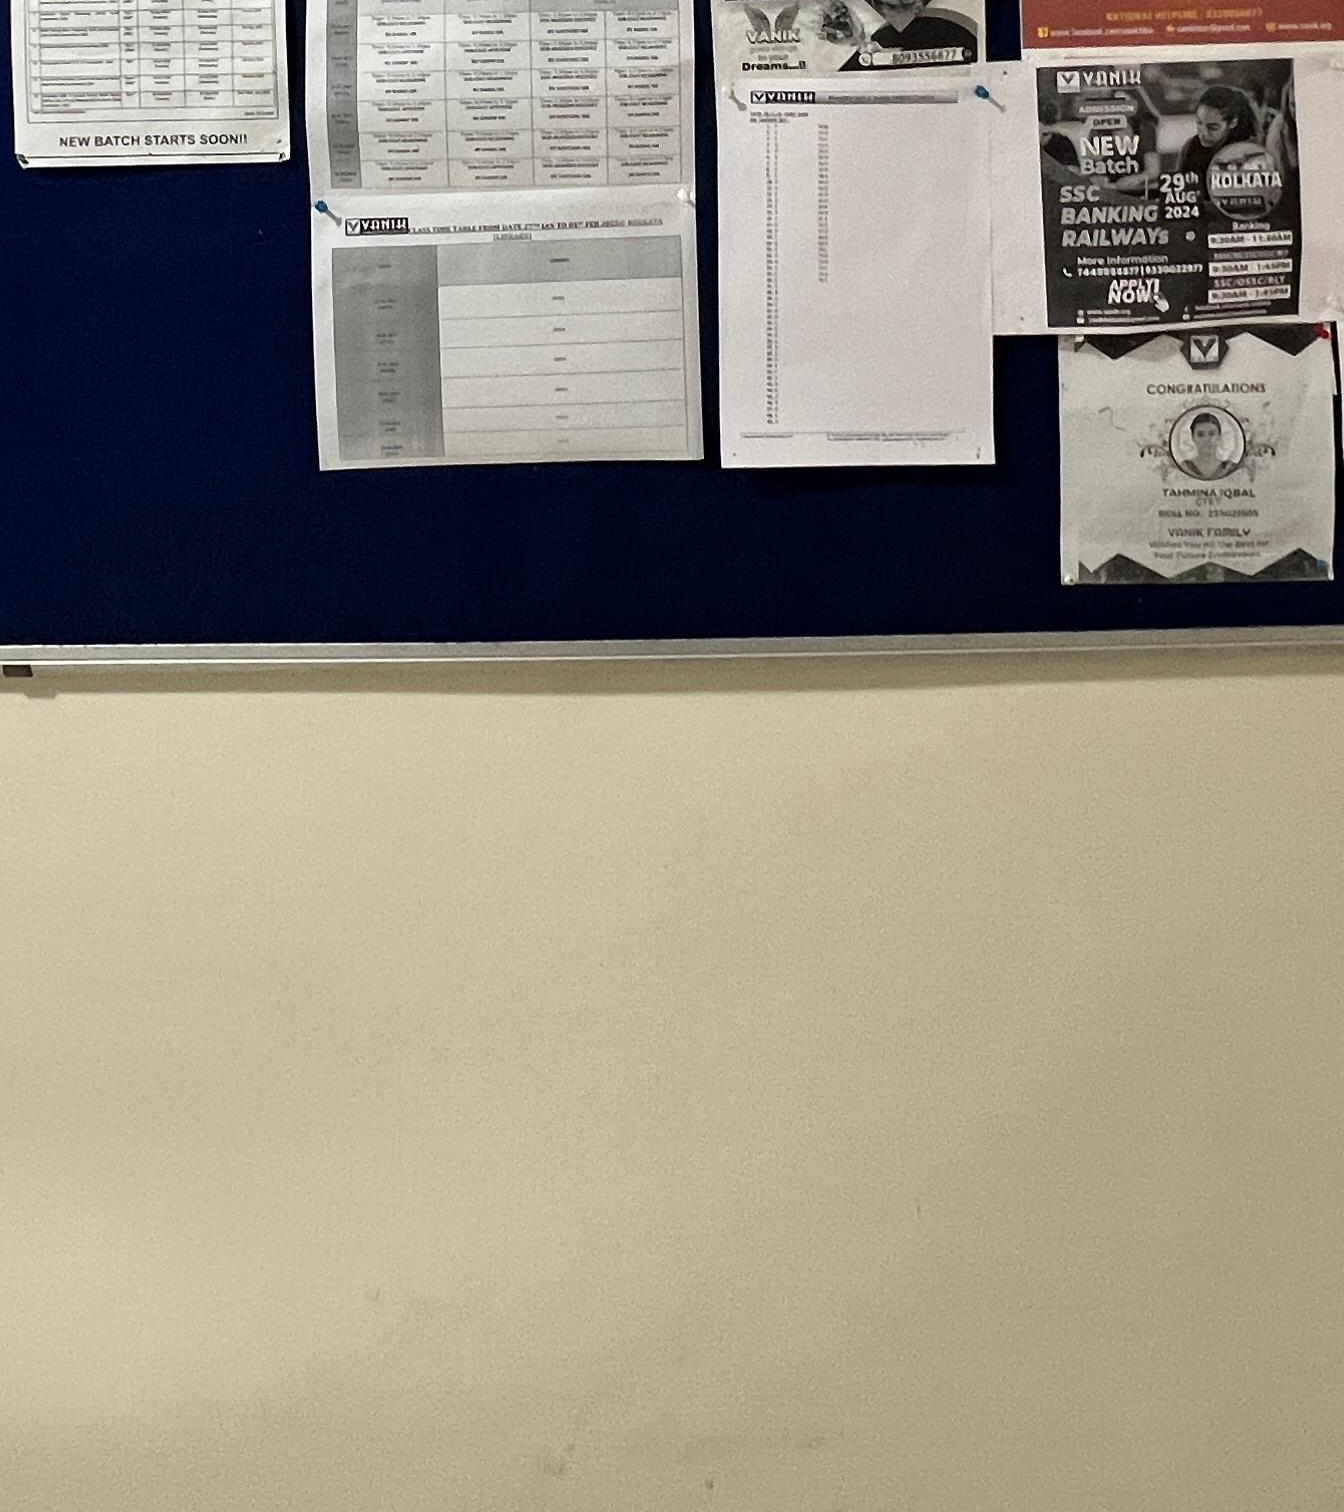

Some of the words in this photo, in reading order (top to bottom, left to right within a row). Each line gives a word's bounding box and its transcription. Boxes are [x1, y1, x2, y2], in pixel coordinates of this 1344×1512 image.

[746, 29, 800, 44] VANIK
[1093, 118, 1121, 126] OPEN
[59, 136, 91, 148] NEW
[94, 135, 140, 147] BATCH
[144, 133, 195, 146] STARTS
[1080, 135, 1139, 156] NEW
[1080, 157, 1139, 174] Batch
[1160, 172, 1199, 193] 29th
[1211, 171, 1282, 190] KOLKATA
[1059, 185, 1101, 203] SSC
[1061, 205, 1158, 225] BANKING
[1165, 205, 1199, 219] 2024
[1077, 256, 1104, 266] More
[1107, 254, 1169, 265] Information
[1146, 383, 1266, 395] CONGRATULATIONS
[1162, 488, 1217, 498] TAHMINA
[1219, 488, 1256, 499] IQBAL
[1168, 528, 1204, 538] VANIK
[1207, 527, 1251, 537] FAMILY
